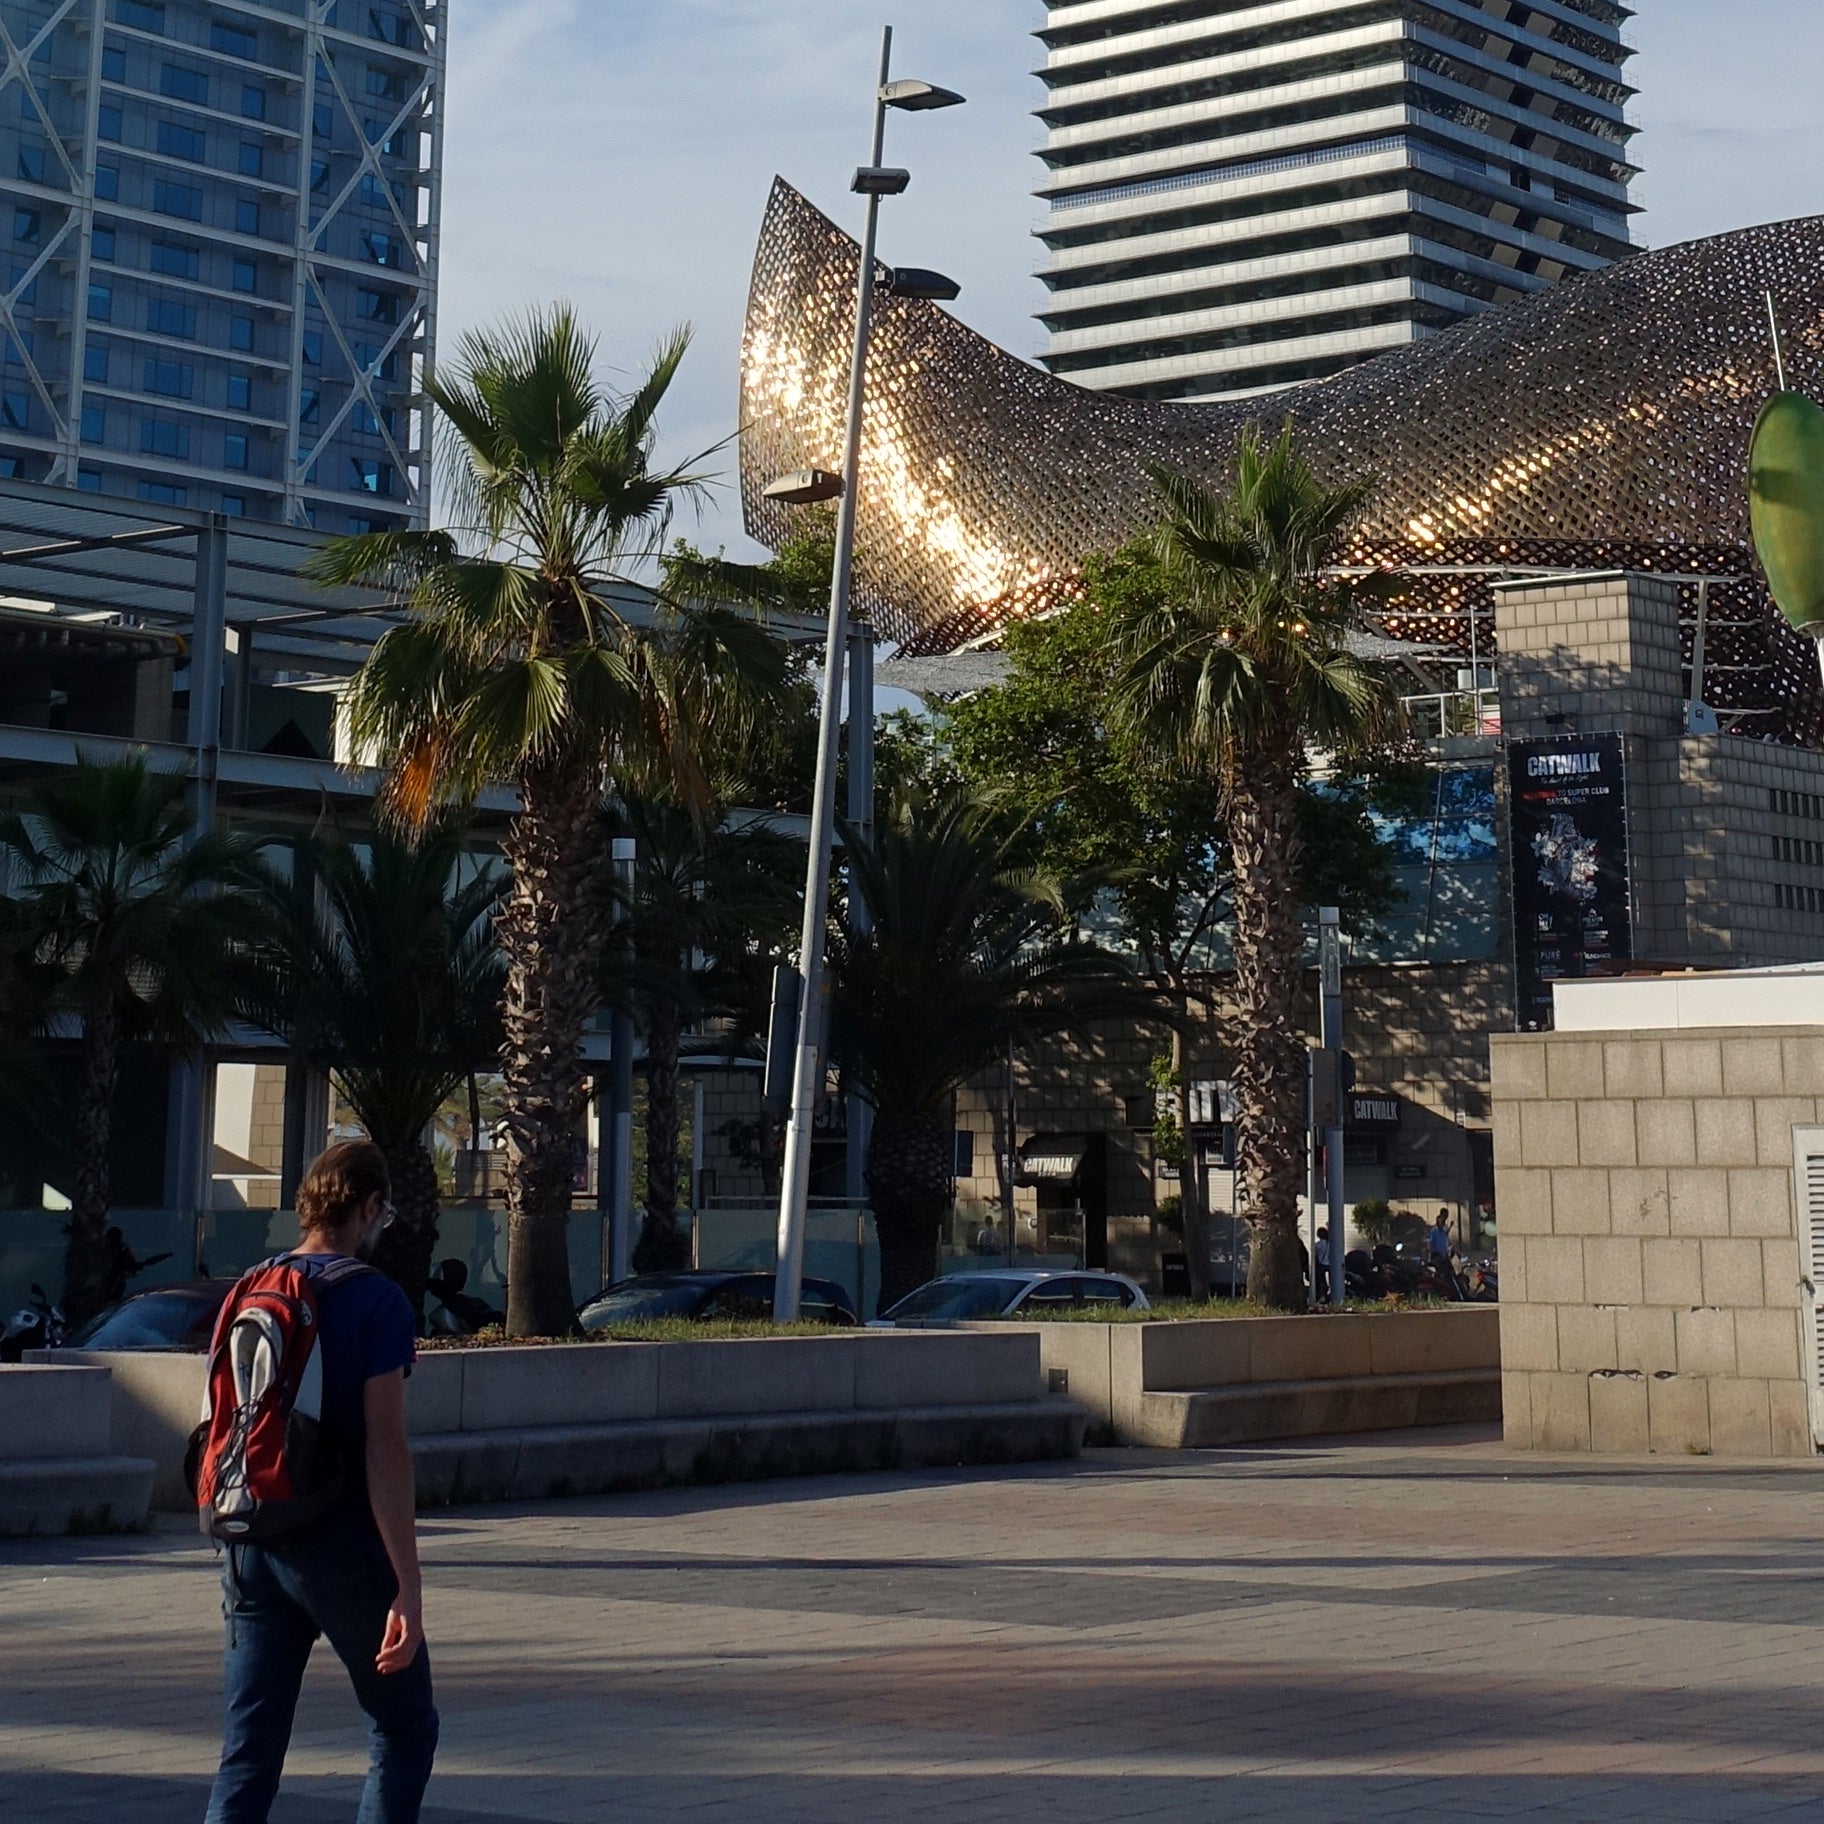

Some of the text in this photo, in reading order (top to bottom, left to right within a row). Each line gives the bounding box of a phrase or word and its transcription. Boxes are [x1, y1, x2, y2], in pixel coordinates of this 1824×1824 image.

[1527, 752, 1601, 776] CATWALK
[1591, 786, 1610, 796] CLUB
[1354, 1099, 1398, 1120] CATWALK
[1023, 1156, 1074, 1173] CATWALK
